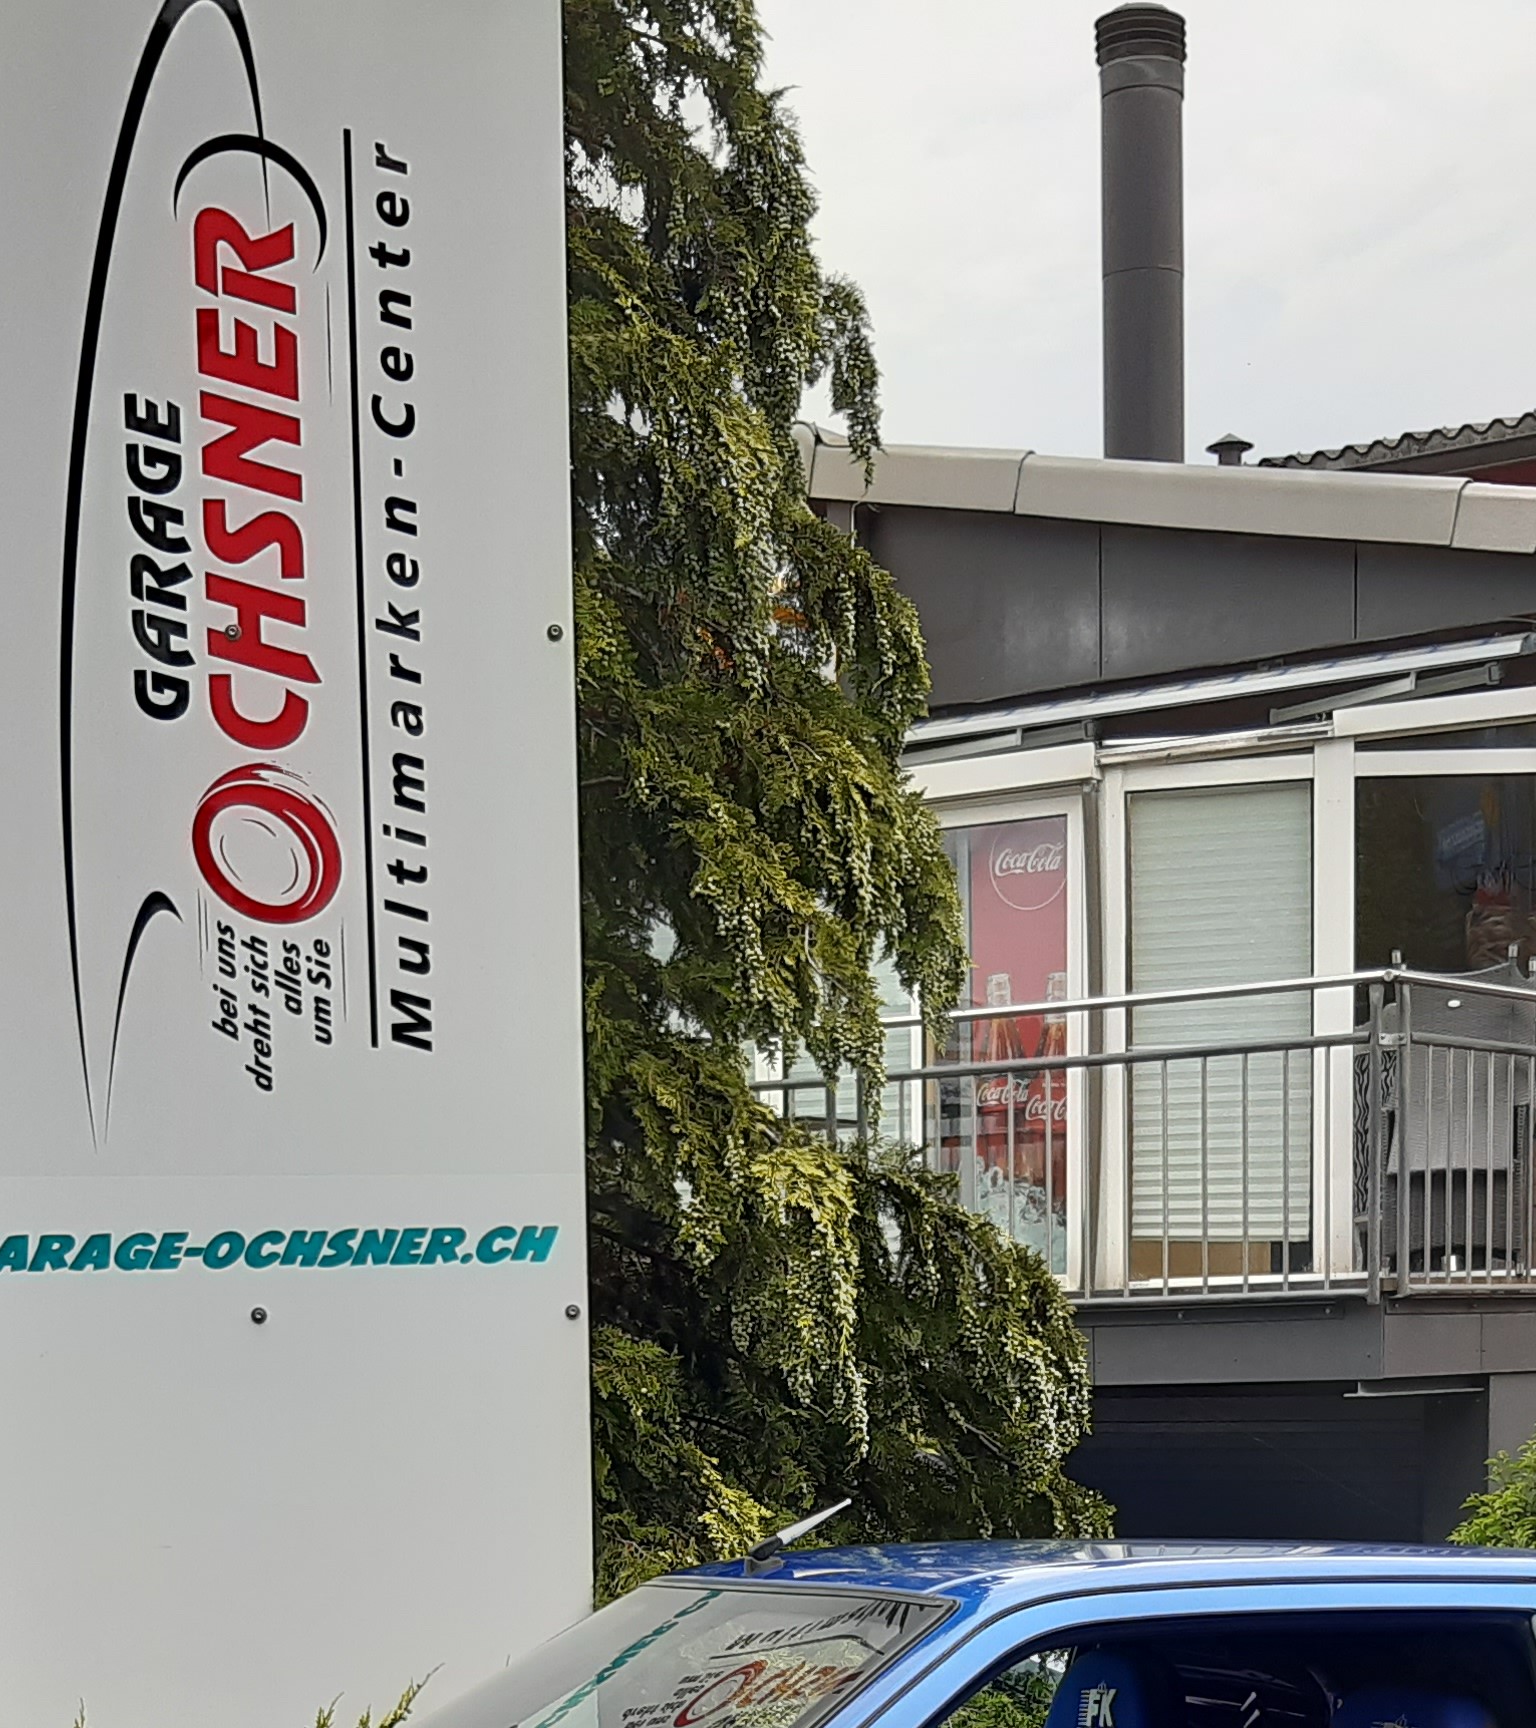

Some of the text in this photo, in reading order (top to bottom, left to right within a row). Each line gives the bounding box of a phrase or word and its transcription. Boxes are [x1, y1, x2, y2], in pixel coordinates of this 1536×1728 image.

[122, 391, 194, 722] GARAGE
[191, 206, 342, 925] OCHSNER
[368, 141, 433, 1053] Multimarken-Center
[211, 919, 240, 1042] bei uns
[240, 934, 274, 1093] dreht sich
[273, 938, 304, 1017] alles
[305, 937, 334, 1046] um Sie
[1085, 1688, 1117, 1728] FK
